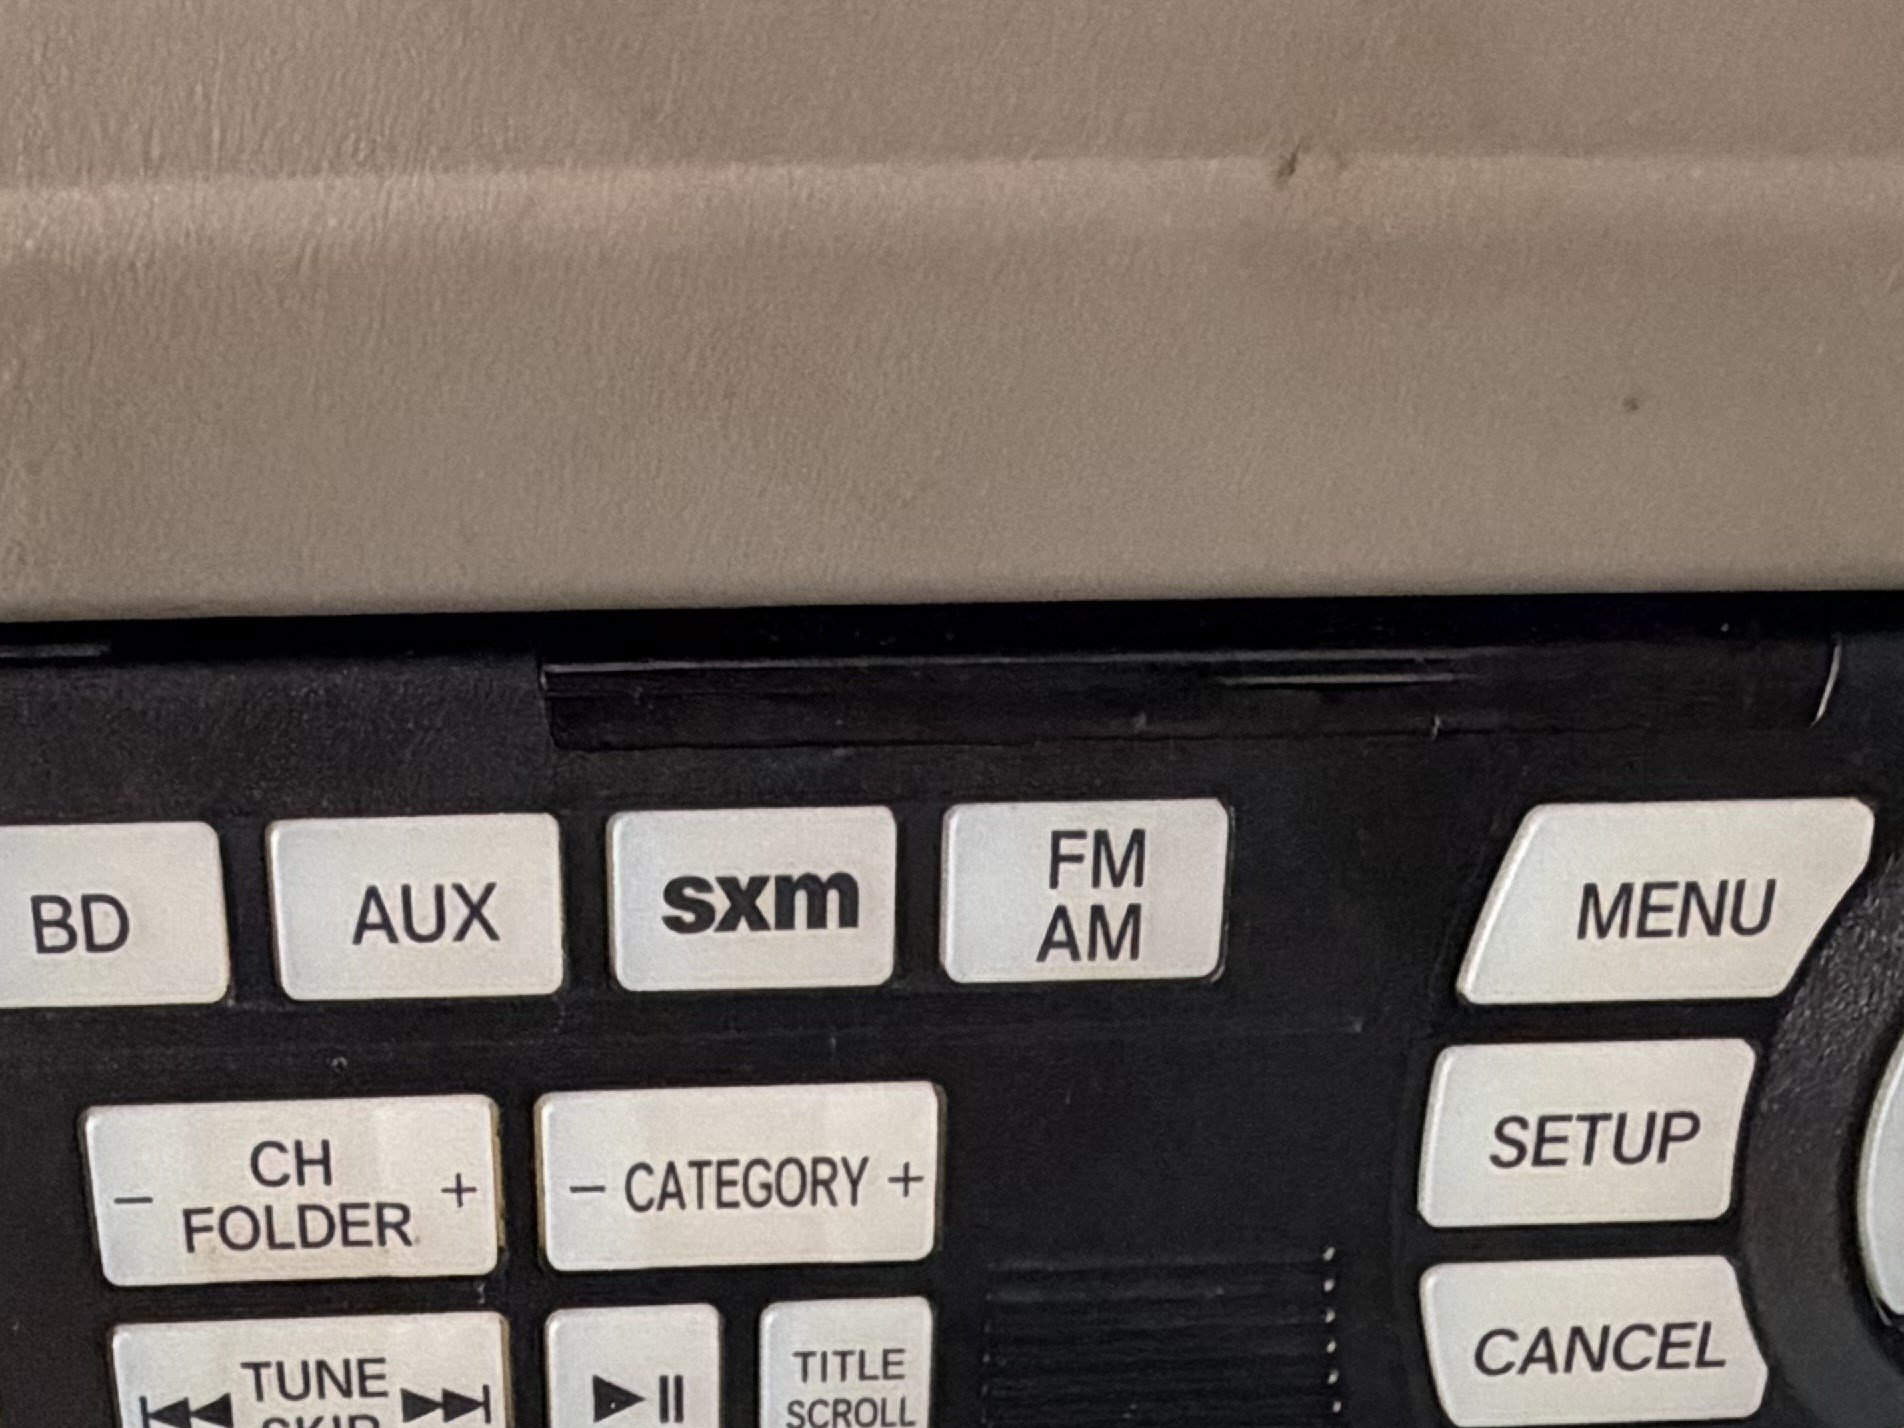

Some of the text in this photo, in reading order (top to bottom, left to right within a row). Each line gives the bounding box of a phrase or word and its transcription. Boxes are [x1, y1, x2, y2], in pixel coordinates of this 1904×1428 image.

[1048, 827, 1147, 891] FM
[29, 893, 131, 955] BD
[351, 881, 501, 947] AUX
[661, 870, 861, 935] sxm
[1035, 901, 1143, 963] AM
[1576, 877, 1777, 941] MENU
[249, 1137, 333, 1189] CH
[1488, 1109, 1702, 1170] SETUP
[623, 1155, 871, 1214] CATEGORY
[181, 1201, 414, 1255] FOLDER
[791, 1347, 907, 1385] TITLE
[1473, 1319, 1727, 1377] CANCEL
[239, 1356, 390, 1403] TUNE
